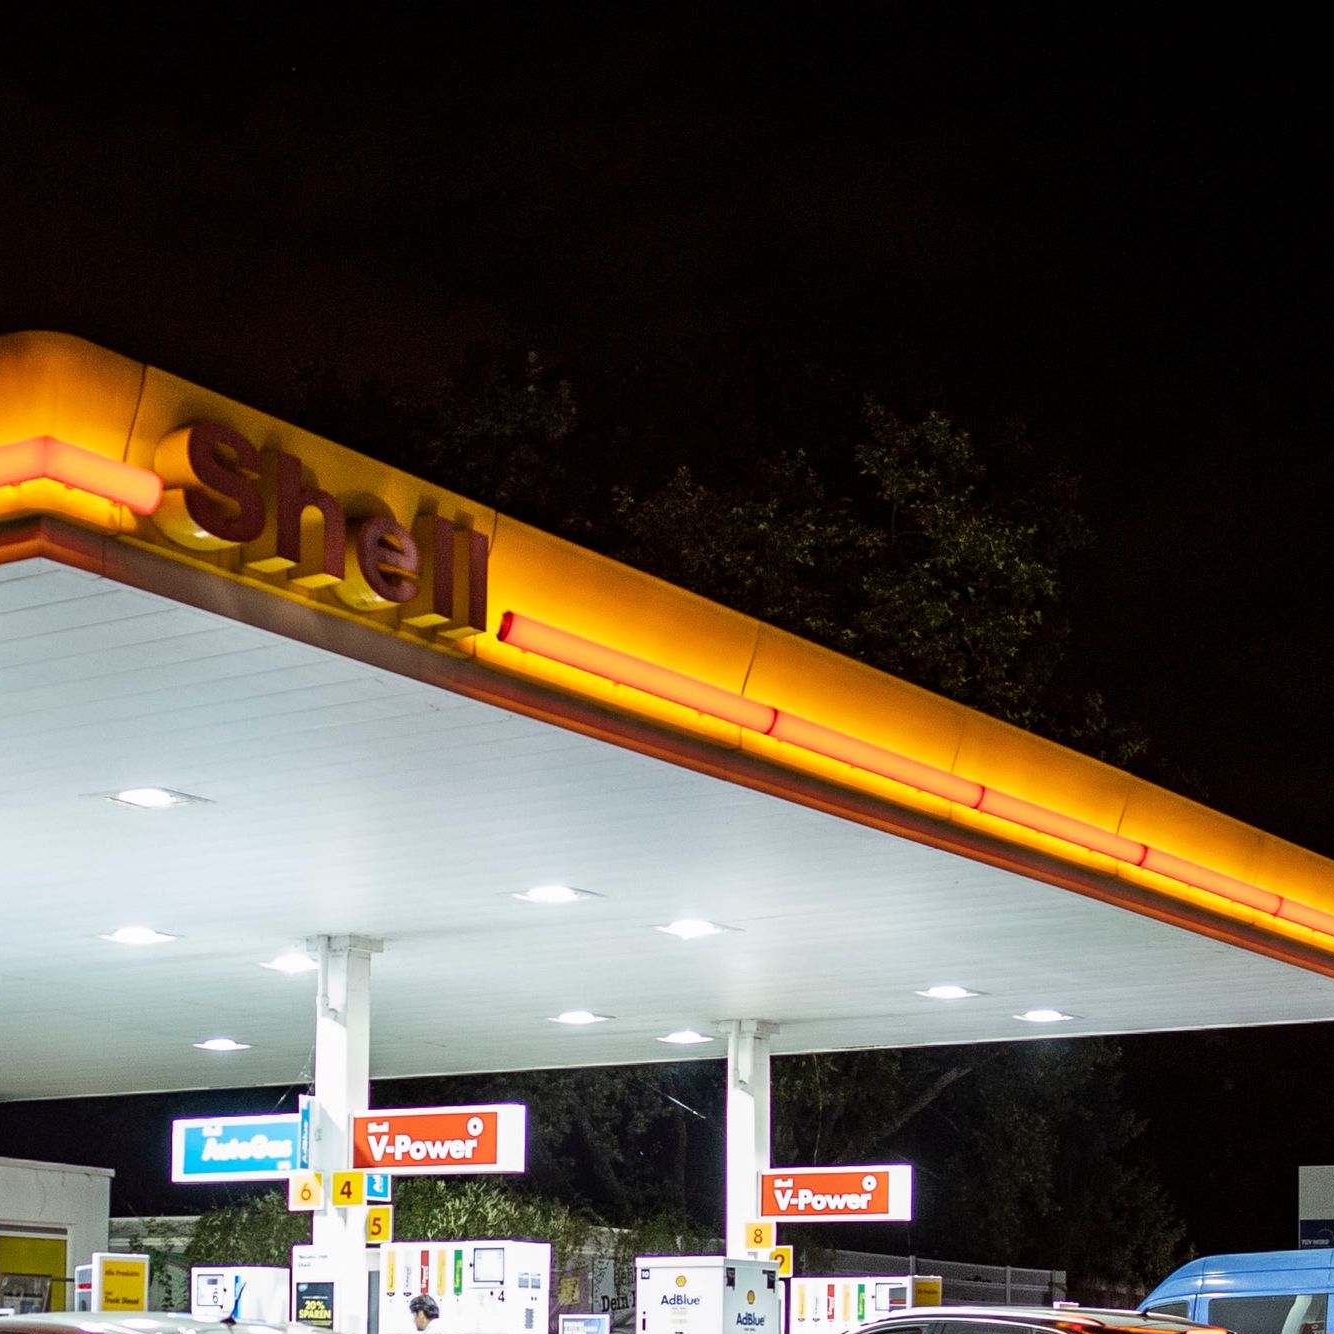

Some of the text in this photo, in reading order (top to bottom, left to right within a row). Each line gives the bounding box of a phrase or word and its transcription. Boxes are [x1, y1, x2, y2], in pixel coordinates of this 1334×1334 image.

[165, 421, 489, 635] Shell
[368, 1134, 477, 1161] V-Power
[301, 1183, 312, 1201] 6
[340, 1181, 352, 1199] 4
[774, 1189, 872, 1212] V-Power
[371, 1217, 382, 1236] 5
[754, 1228, 763, 1244] 8
[212, 1291, 219, 1304] 6
[305, 1300, 325, 1310] 20%
[498, 1290, 505, 1303] 4
[601, 1295, 629, 1312] Dein
[299, 1309, 331, 1319] SPAREN
